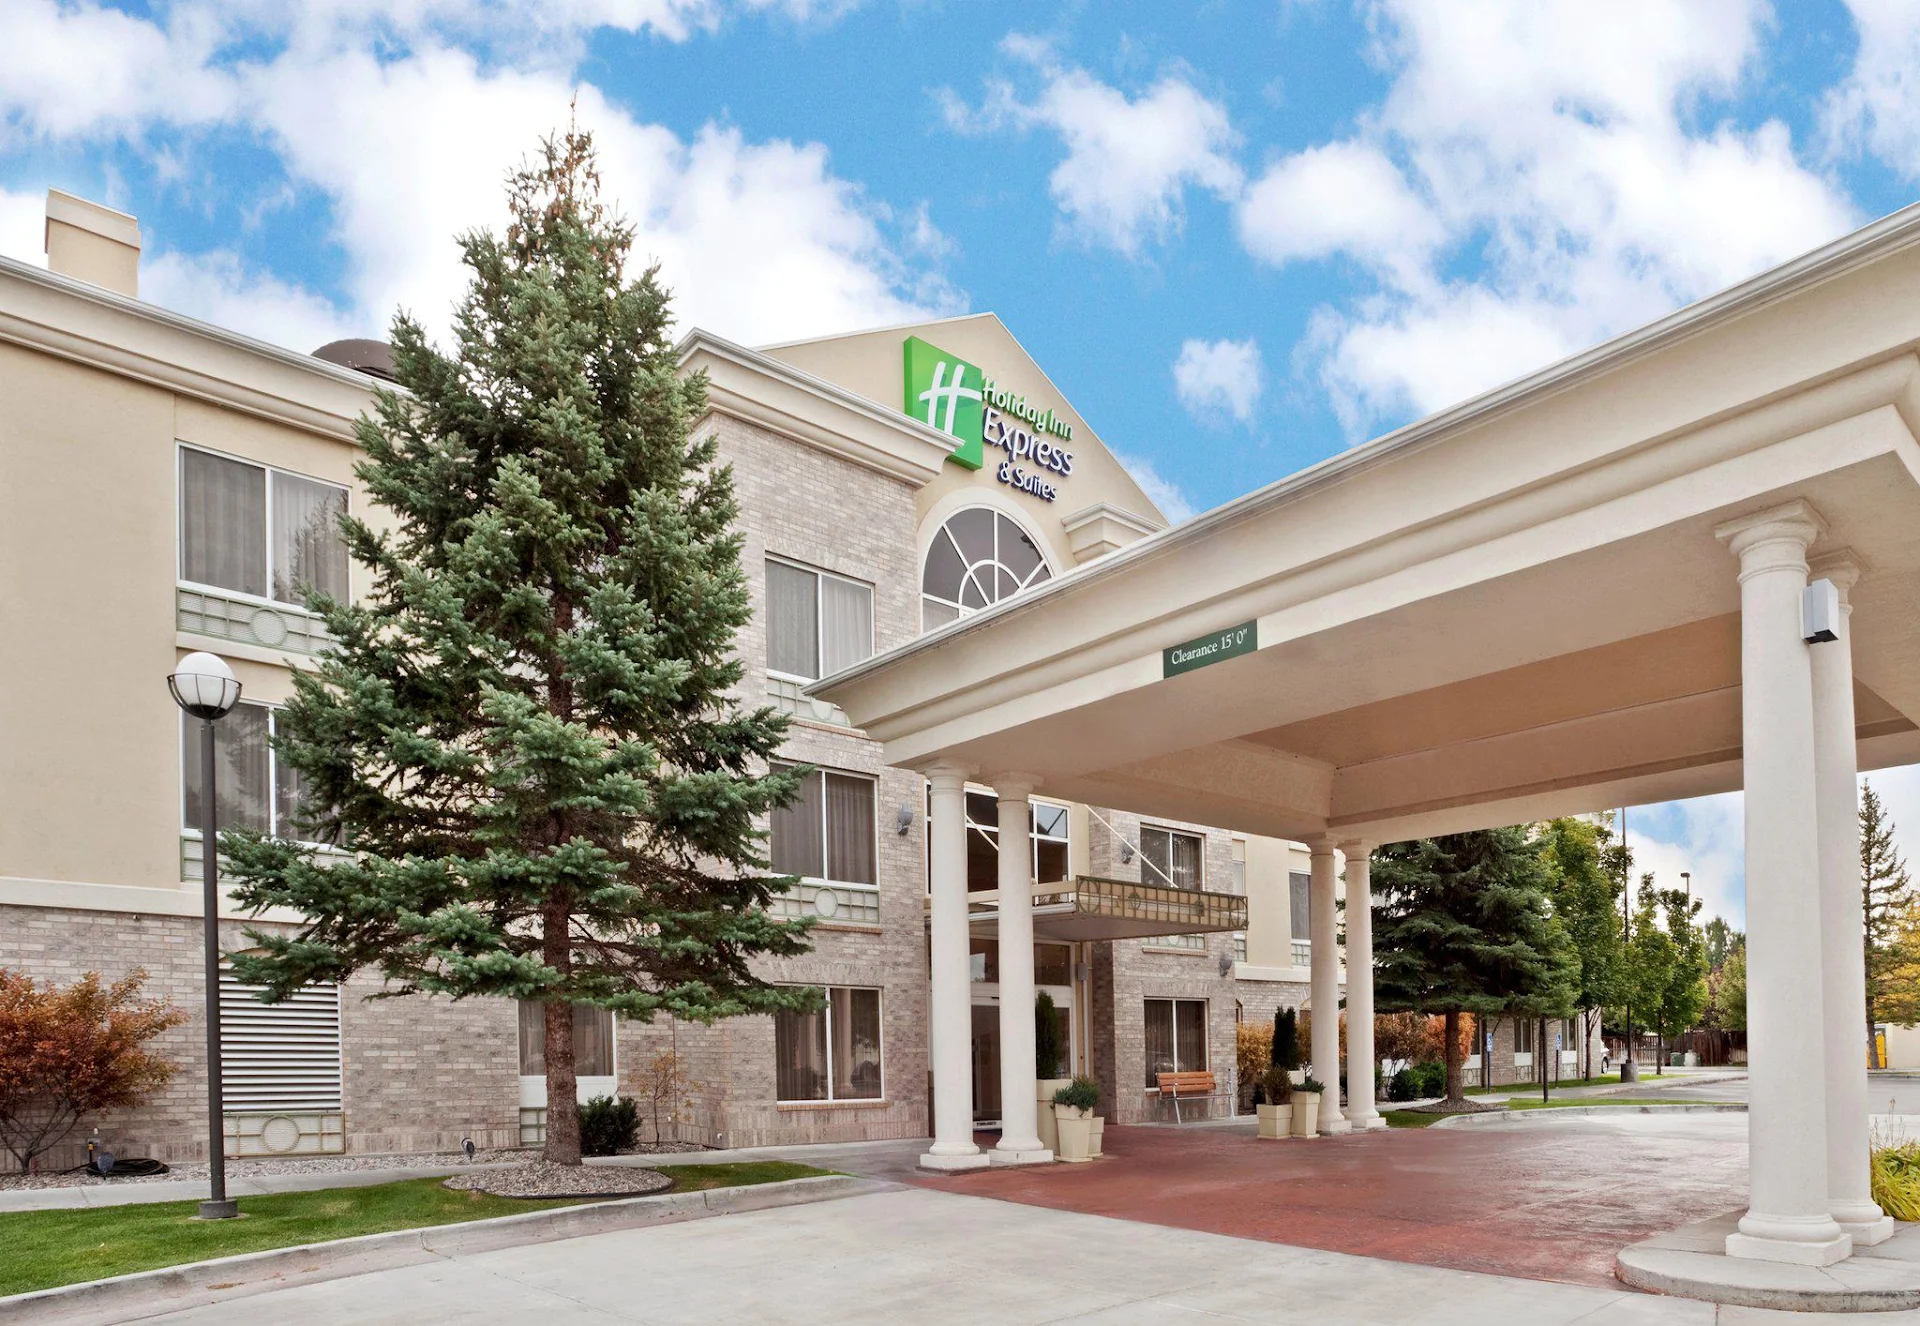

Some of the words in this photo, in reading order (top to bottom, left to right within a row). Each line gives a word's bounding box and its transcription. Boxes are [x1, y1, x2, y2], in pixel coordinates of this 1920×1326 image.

[982, 377, 1047, 432] Holiday
[1048, 408, 1073, 440] Inn
[983, 406, 1075, 476] Express
[998, 460, 1011, 483] &
[1013, 467, 1058, 501] Suites
[1171, 642, 1218, 665] Clearance
[1220, 632, 1234, 650] 15'
[1236, 628, 1248, 645] 0"
